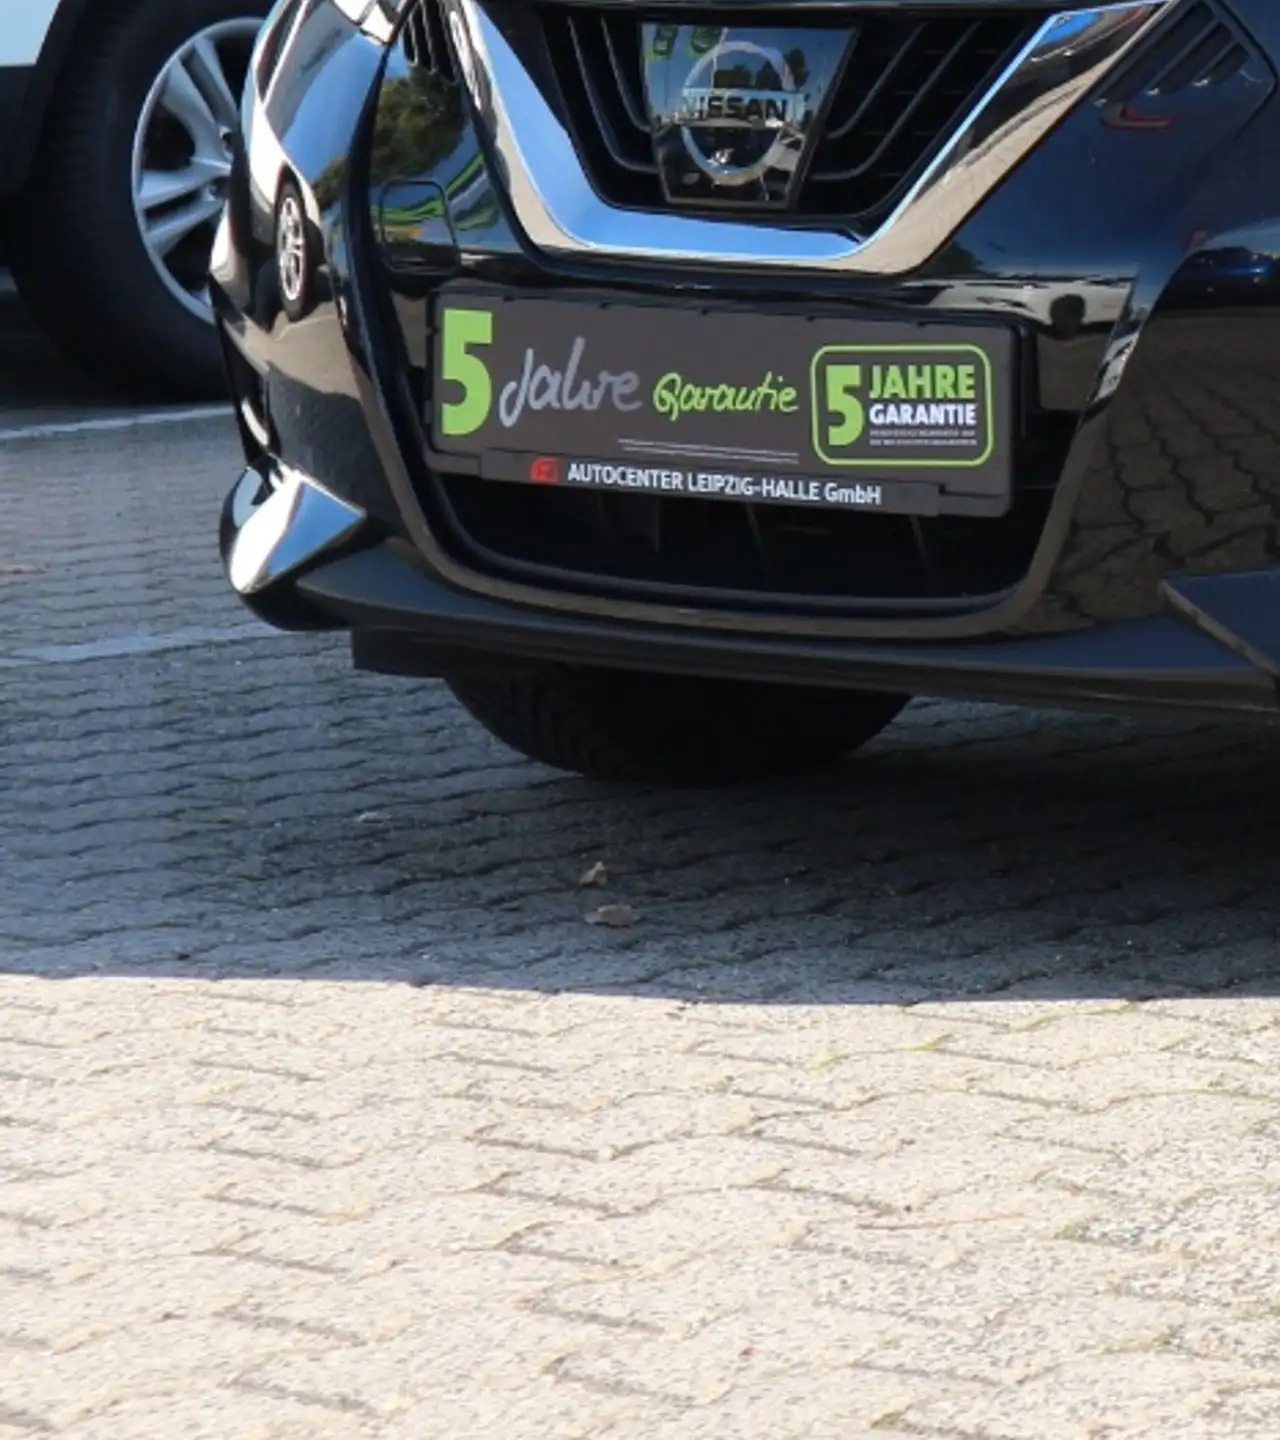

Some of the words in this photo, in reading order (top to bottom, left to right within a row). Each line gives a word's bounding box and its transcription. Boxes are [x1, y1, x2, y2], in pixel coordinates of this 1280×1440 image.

[442, 309, 492, 435] 5
[500, 336, 642, 428] Jahre
[653, 372, 800, 420] Garantie
[826, 364, 864, 446] 5
[869, 364, 975, 399] JAHRE
[869, 403, 977, 426] GARANTIE
[567, 463, 684, 491] AUTOCENTER
[687, 472, 820, 501] LEIPZIG-HALLE
[823, 482, 881, 505] GmbH
